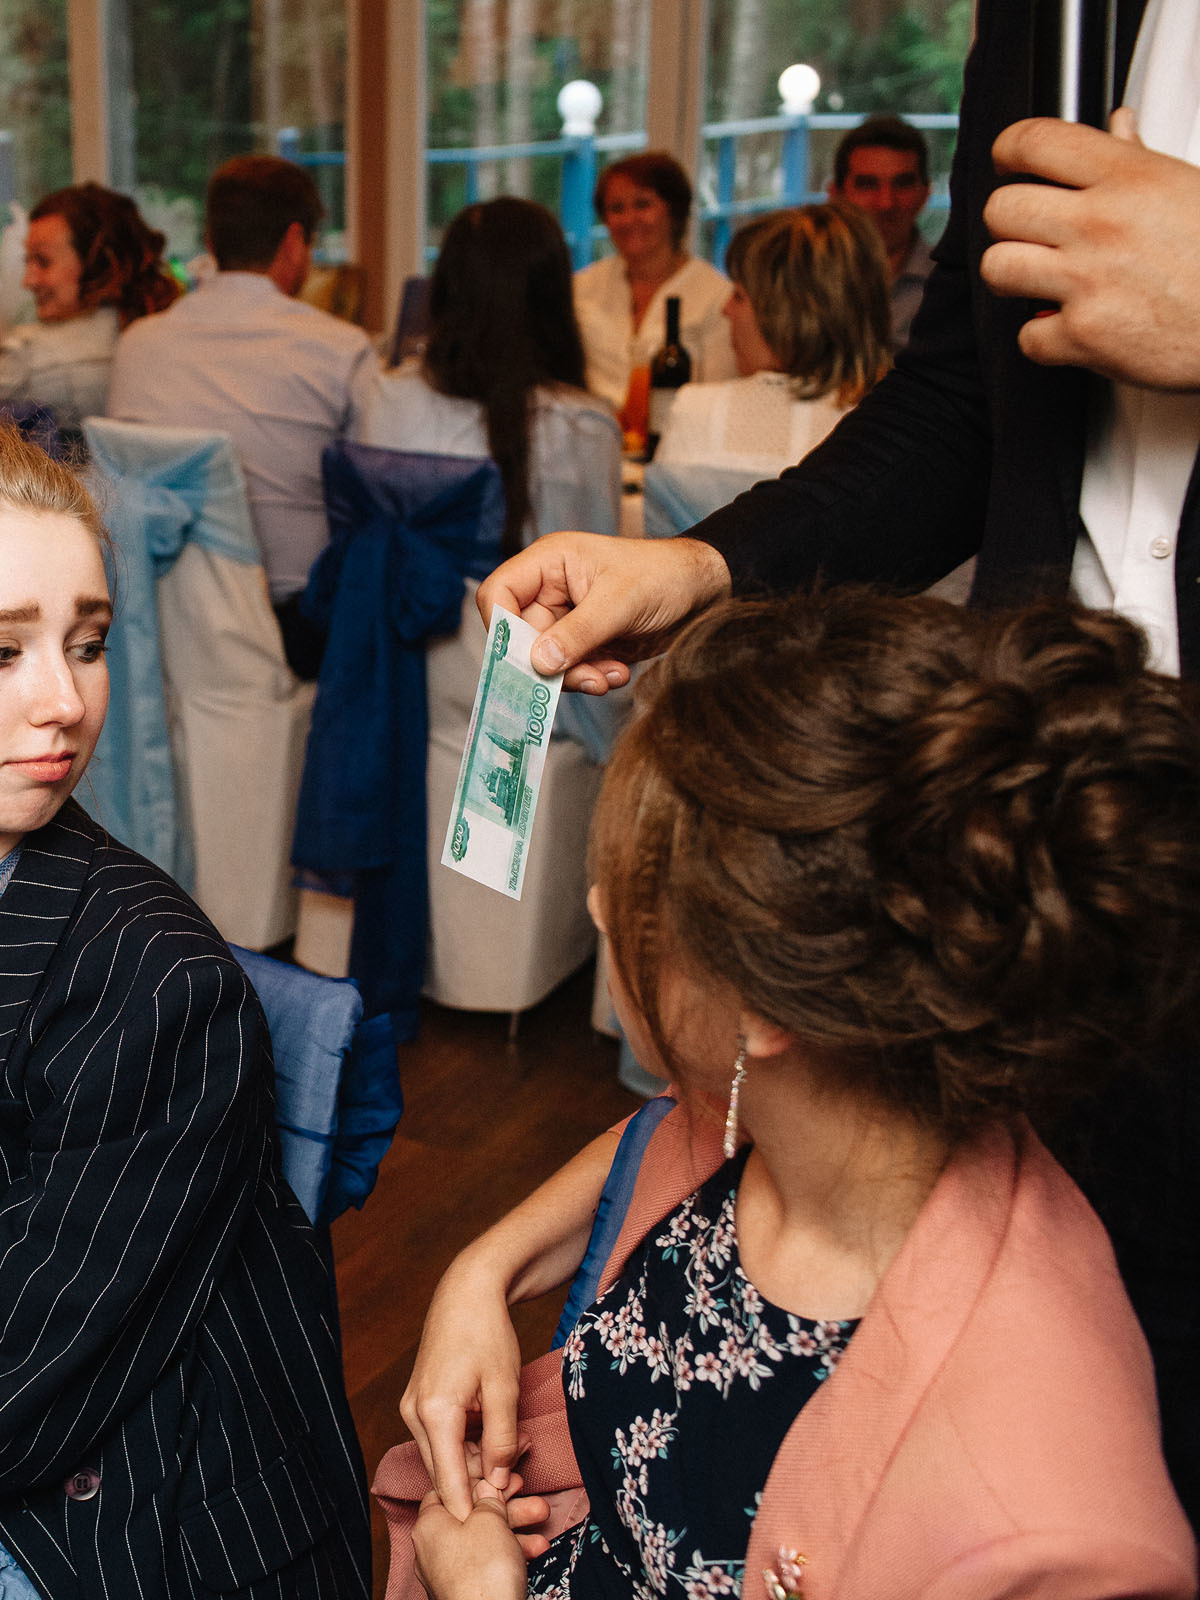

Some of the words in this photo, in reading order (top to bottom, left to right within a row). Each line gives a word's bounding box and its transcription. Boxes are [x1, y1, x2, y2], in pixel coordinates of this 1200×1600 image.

[493, 624, 506, 656] 1000
[525, 683, 551, 747] 1000
[452, 824, 464, 856] 1000
